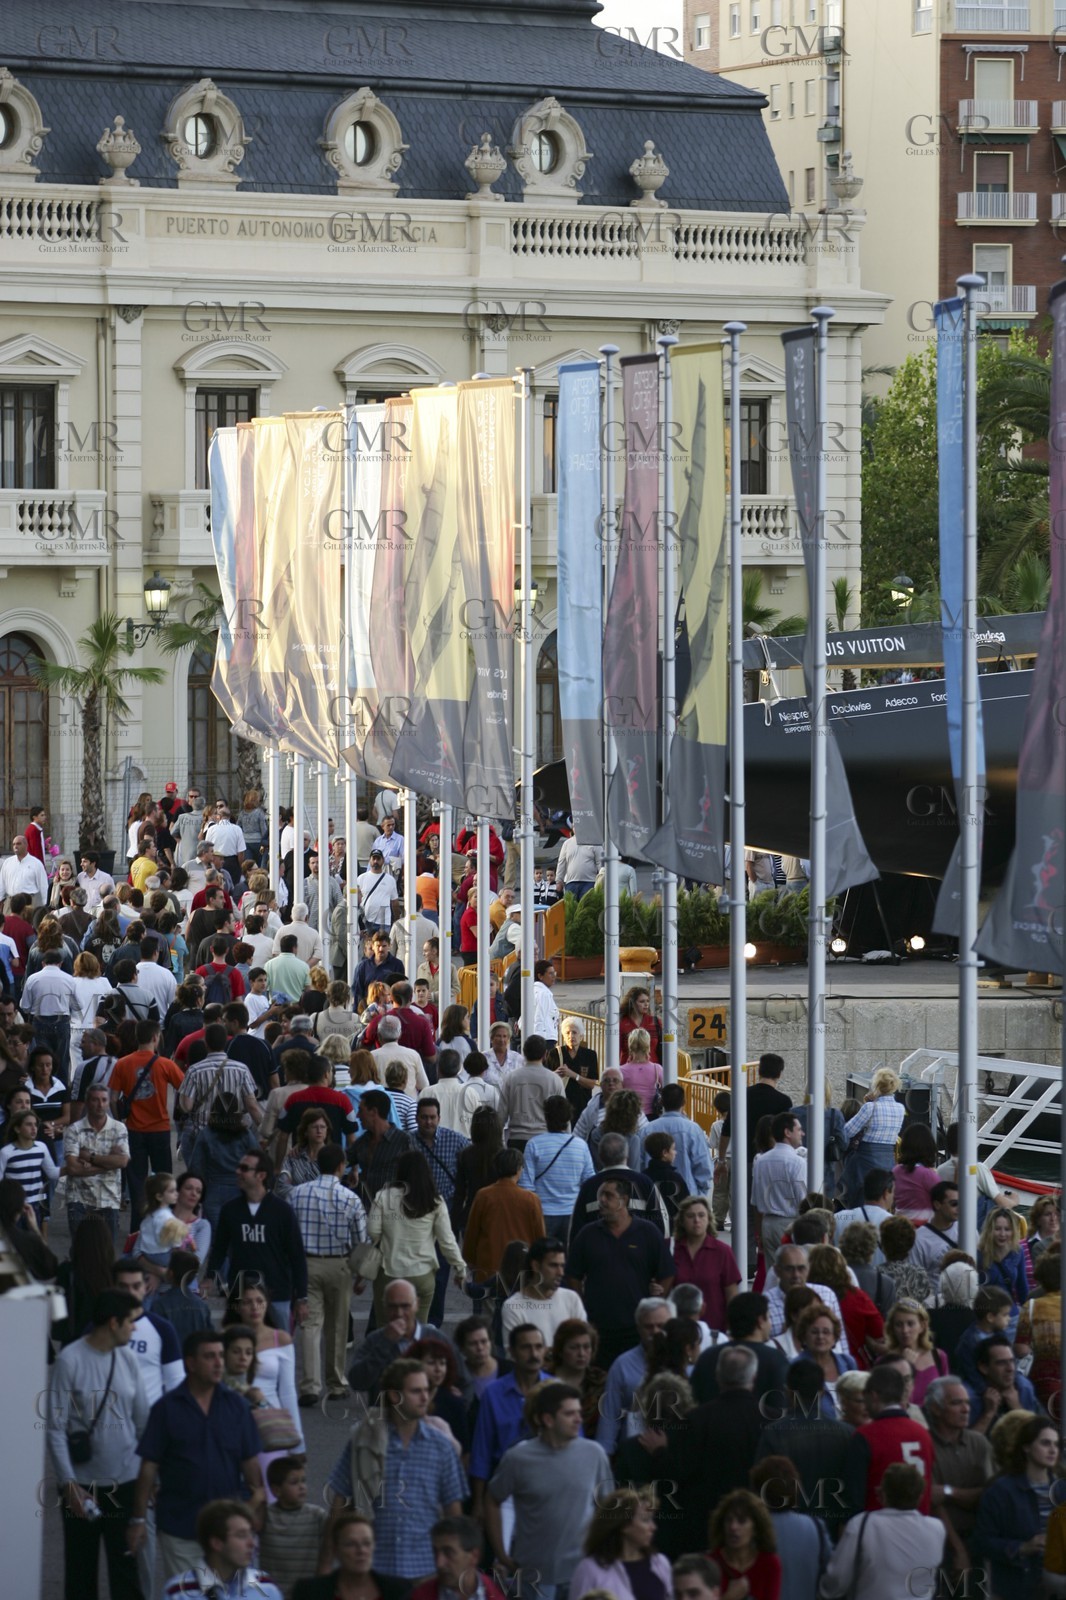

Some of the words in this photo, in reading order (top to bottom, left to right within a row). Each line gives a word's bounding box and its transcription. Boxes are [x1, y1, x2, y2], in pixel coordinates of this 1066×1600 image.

[166, 216, 230, 236] PUERTO
[236, 219, 325, 240] AUTONOMO
[825, 642, 845, 657] UIS
[846, 637, 907, 656] VUITTON
[778, 710, 810, 723] Nespre
[831, 702, 873, 716] Dockwise
[885, 696, 919, 708] Adecco
[692, 1013, 726, 1039] 24
[900, 1441, 925, 1477] 5
